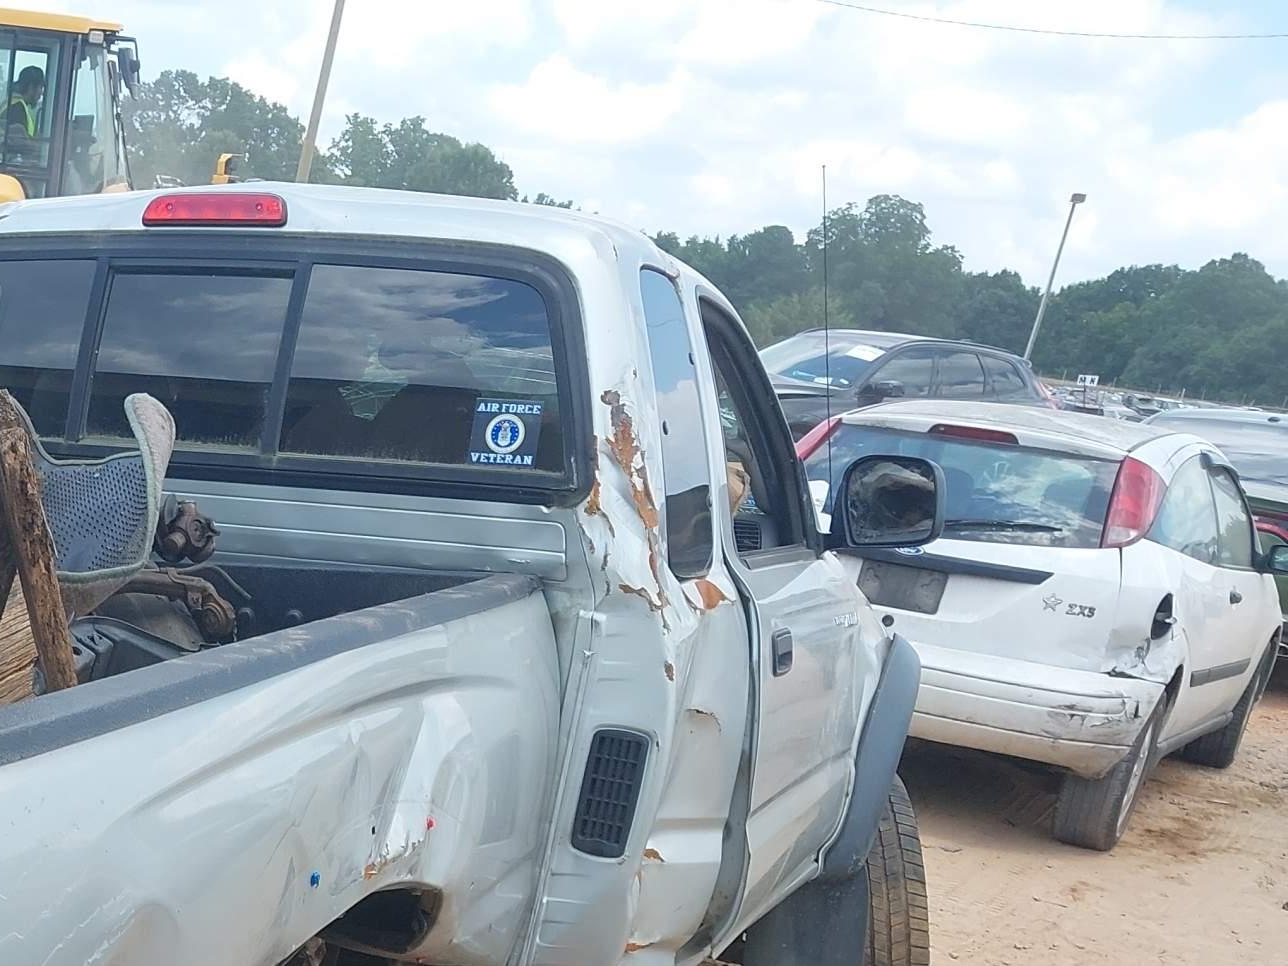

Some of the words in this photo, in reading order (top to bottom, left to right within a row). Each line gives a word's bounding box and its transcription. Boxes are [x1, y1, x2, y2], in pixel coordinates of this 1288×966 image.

[477, 402, 499, 413] AIR
[501, 403, 542, 414] FORCE
[470, 452, 534, 465] VETERAN
